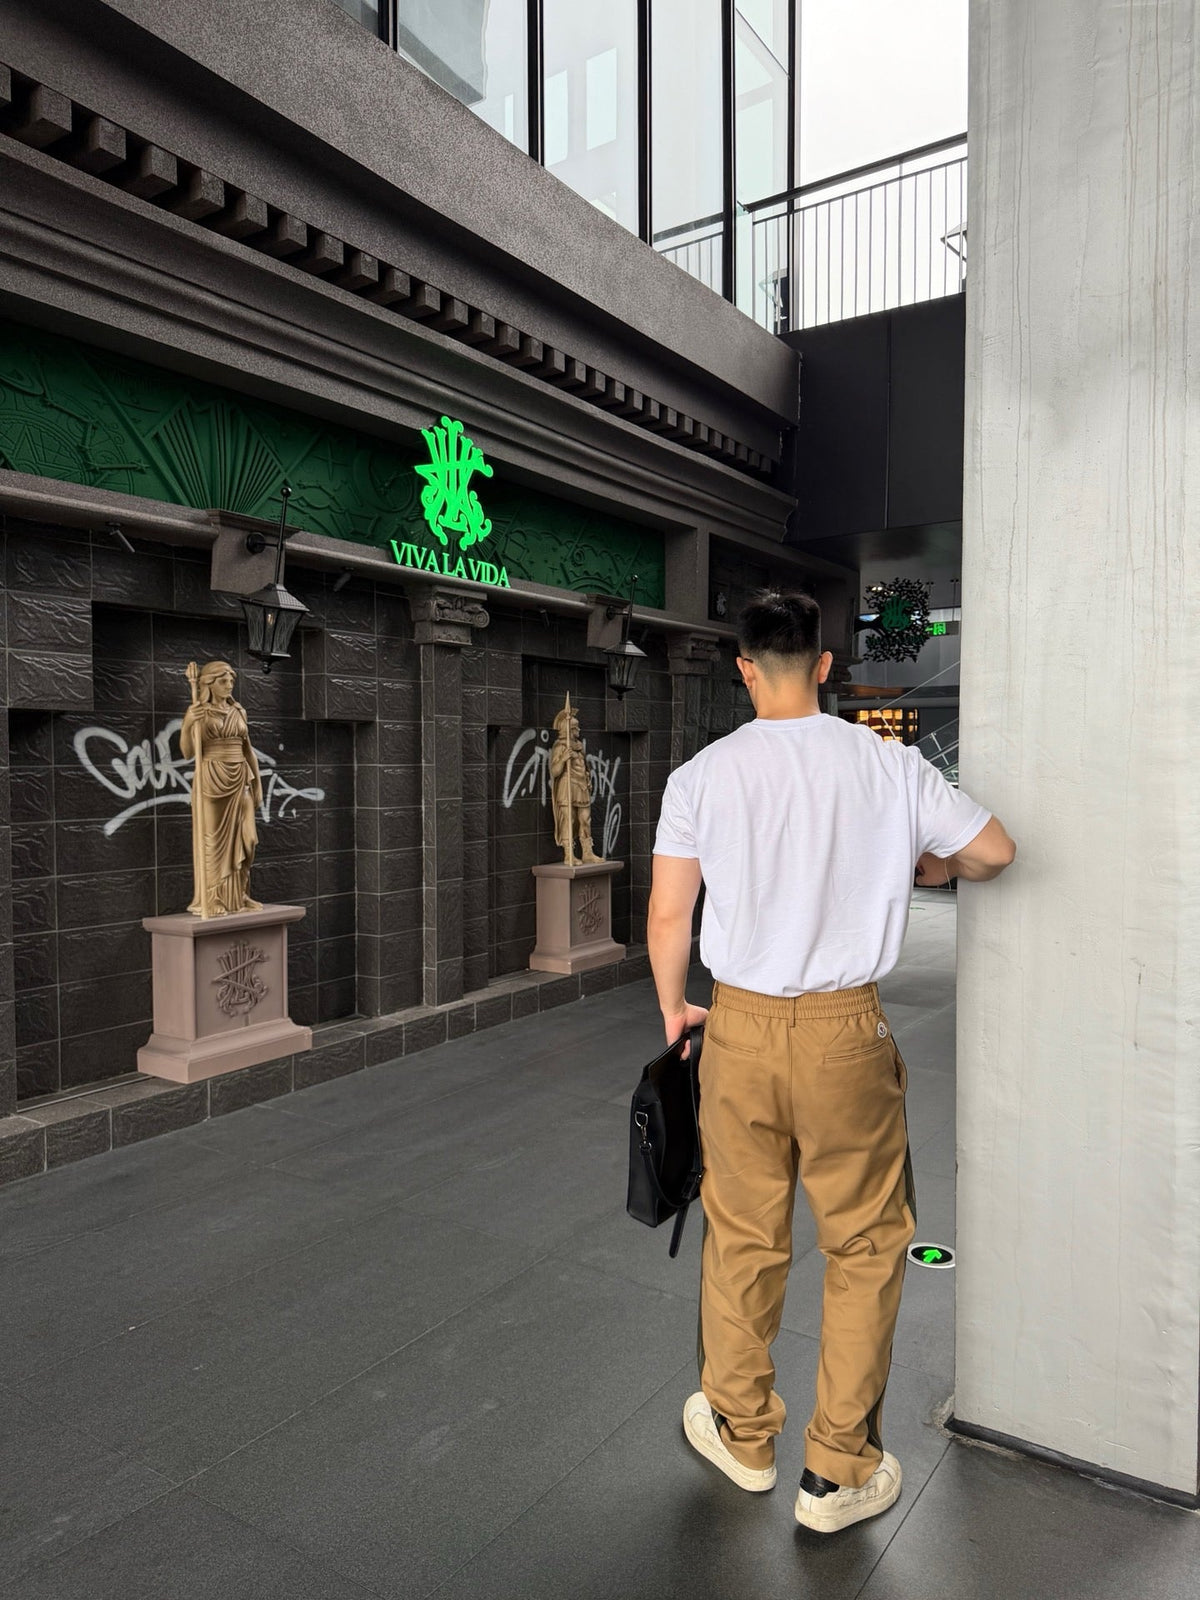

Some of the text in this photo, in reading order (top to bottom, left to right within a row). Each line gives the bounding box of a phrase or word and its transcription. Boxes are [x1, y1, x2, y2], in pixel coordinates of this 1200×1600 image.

[390, 540, 511, 588] VIVA LA VIDA
